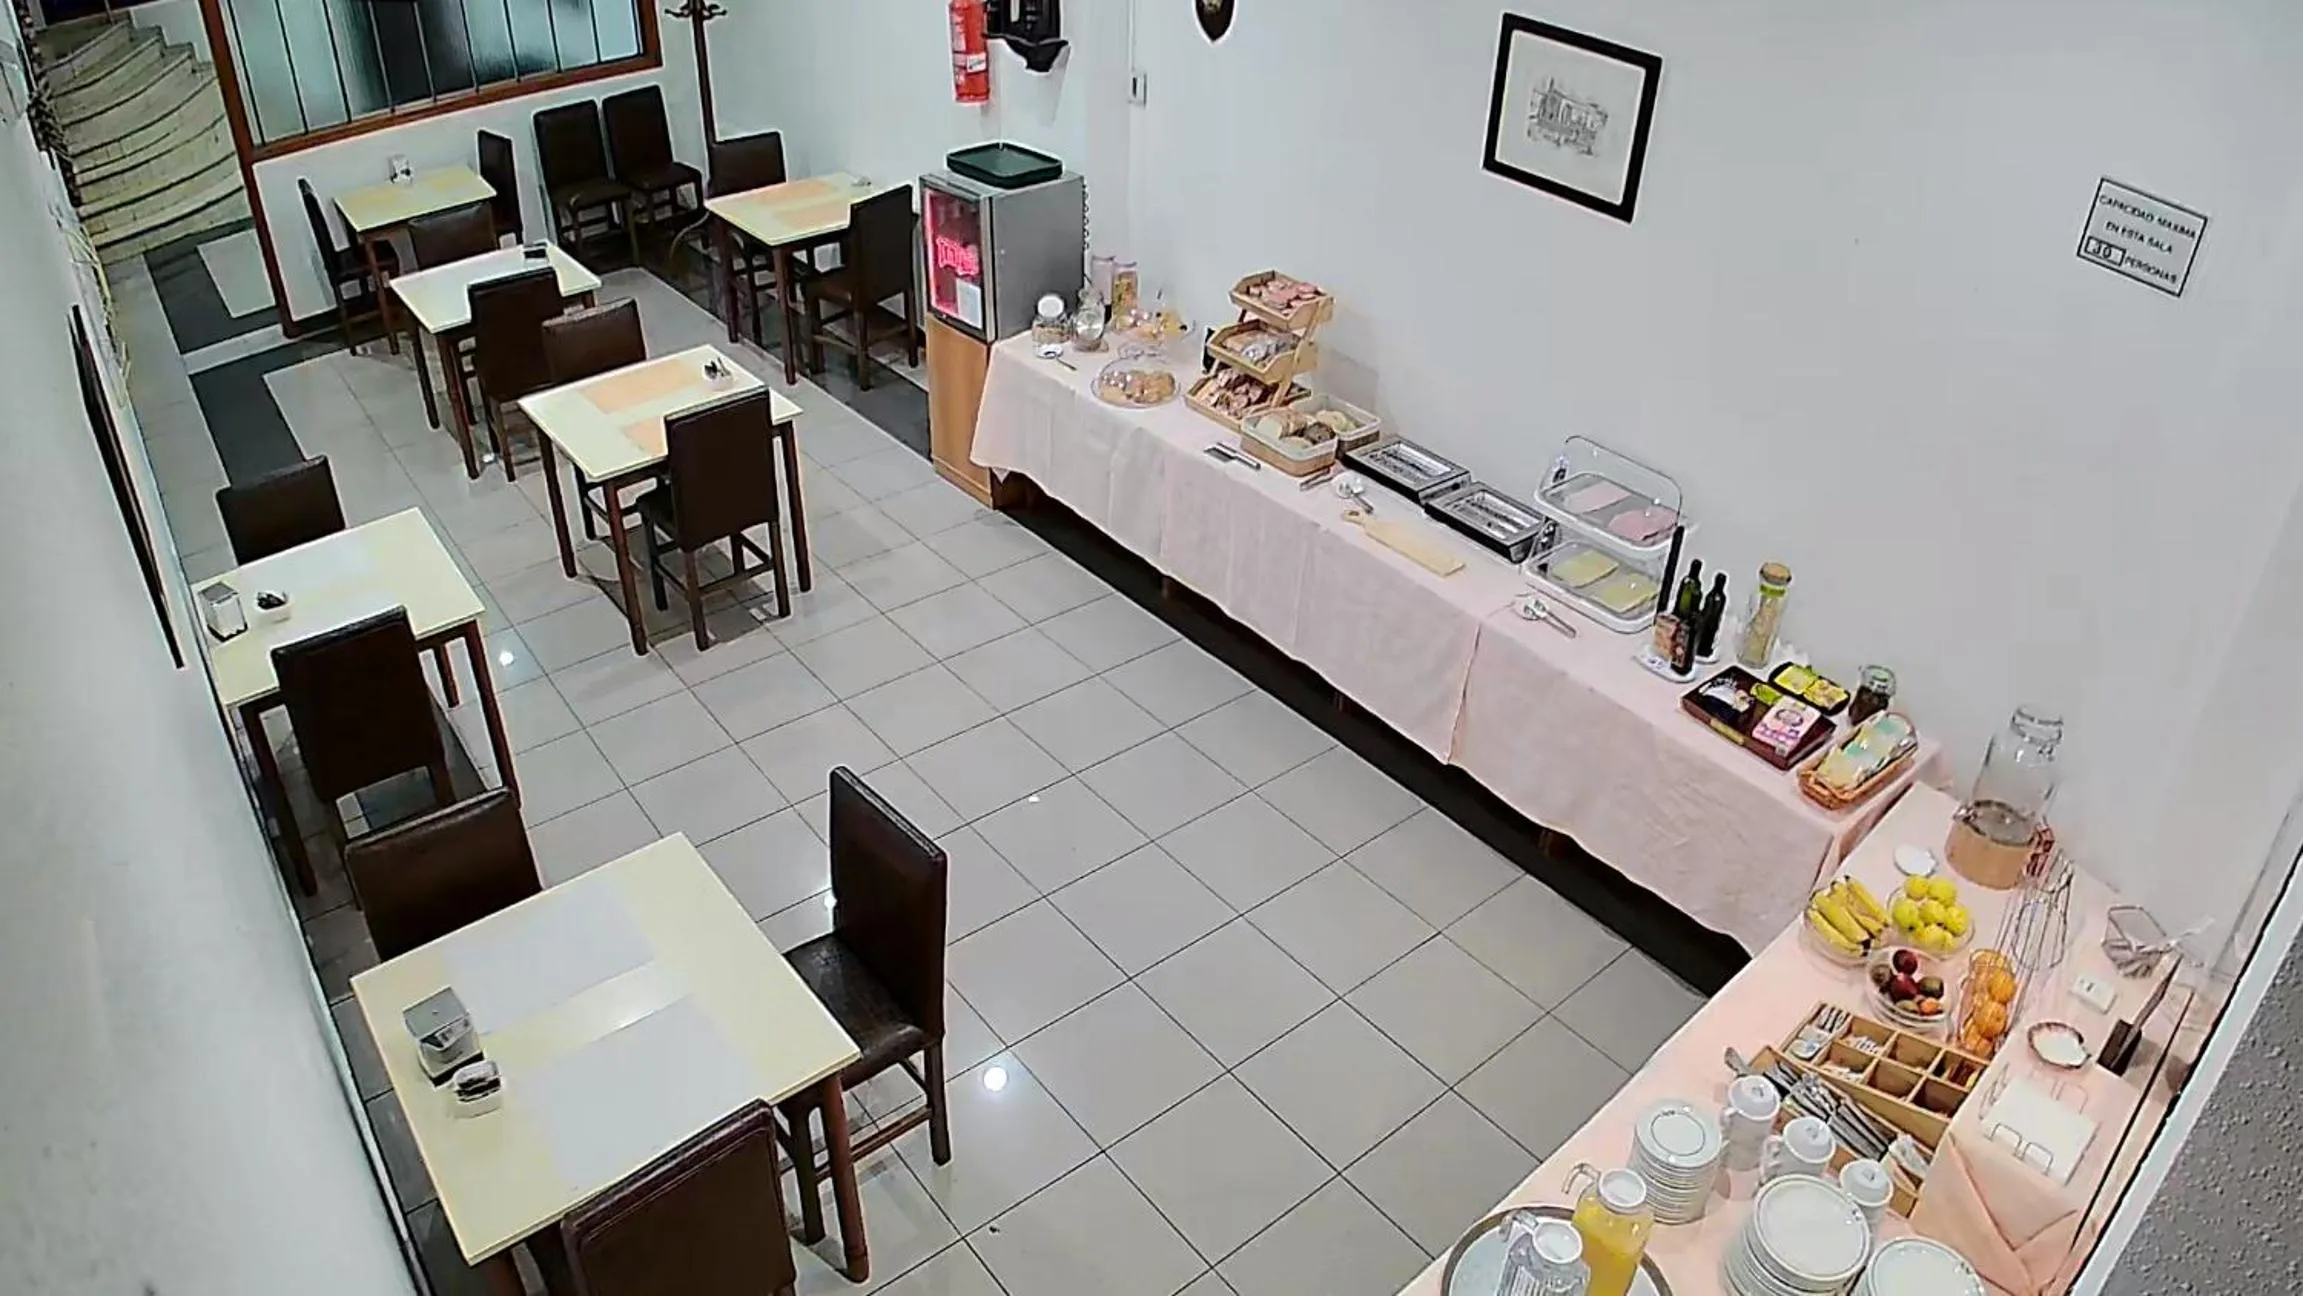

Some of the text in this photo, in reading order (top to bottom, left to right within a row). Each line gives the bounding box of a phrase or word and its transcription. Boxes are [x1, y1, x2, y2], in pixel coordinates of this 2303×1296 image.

[2099, 195, 2155, 222] CAPACIDAD
[2105, 221, 2173, 254] EN ESTA SALA
[2125, 256, 2177, 284] PERSONAS
